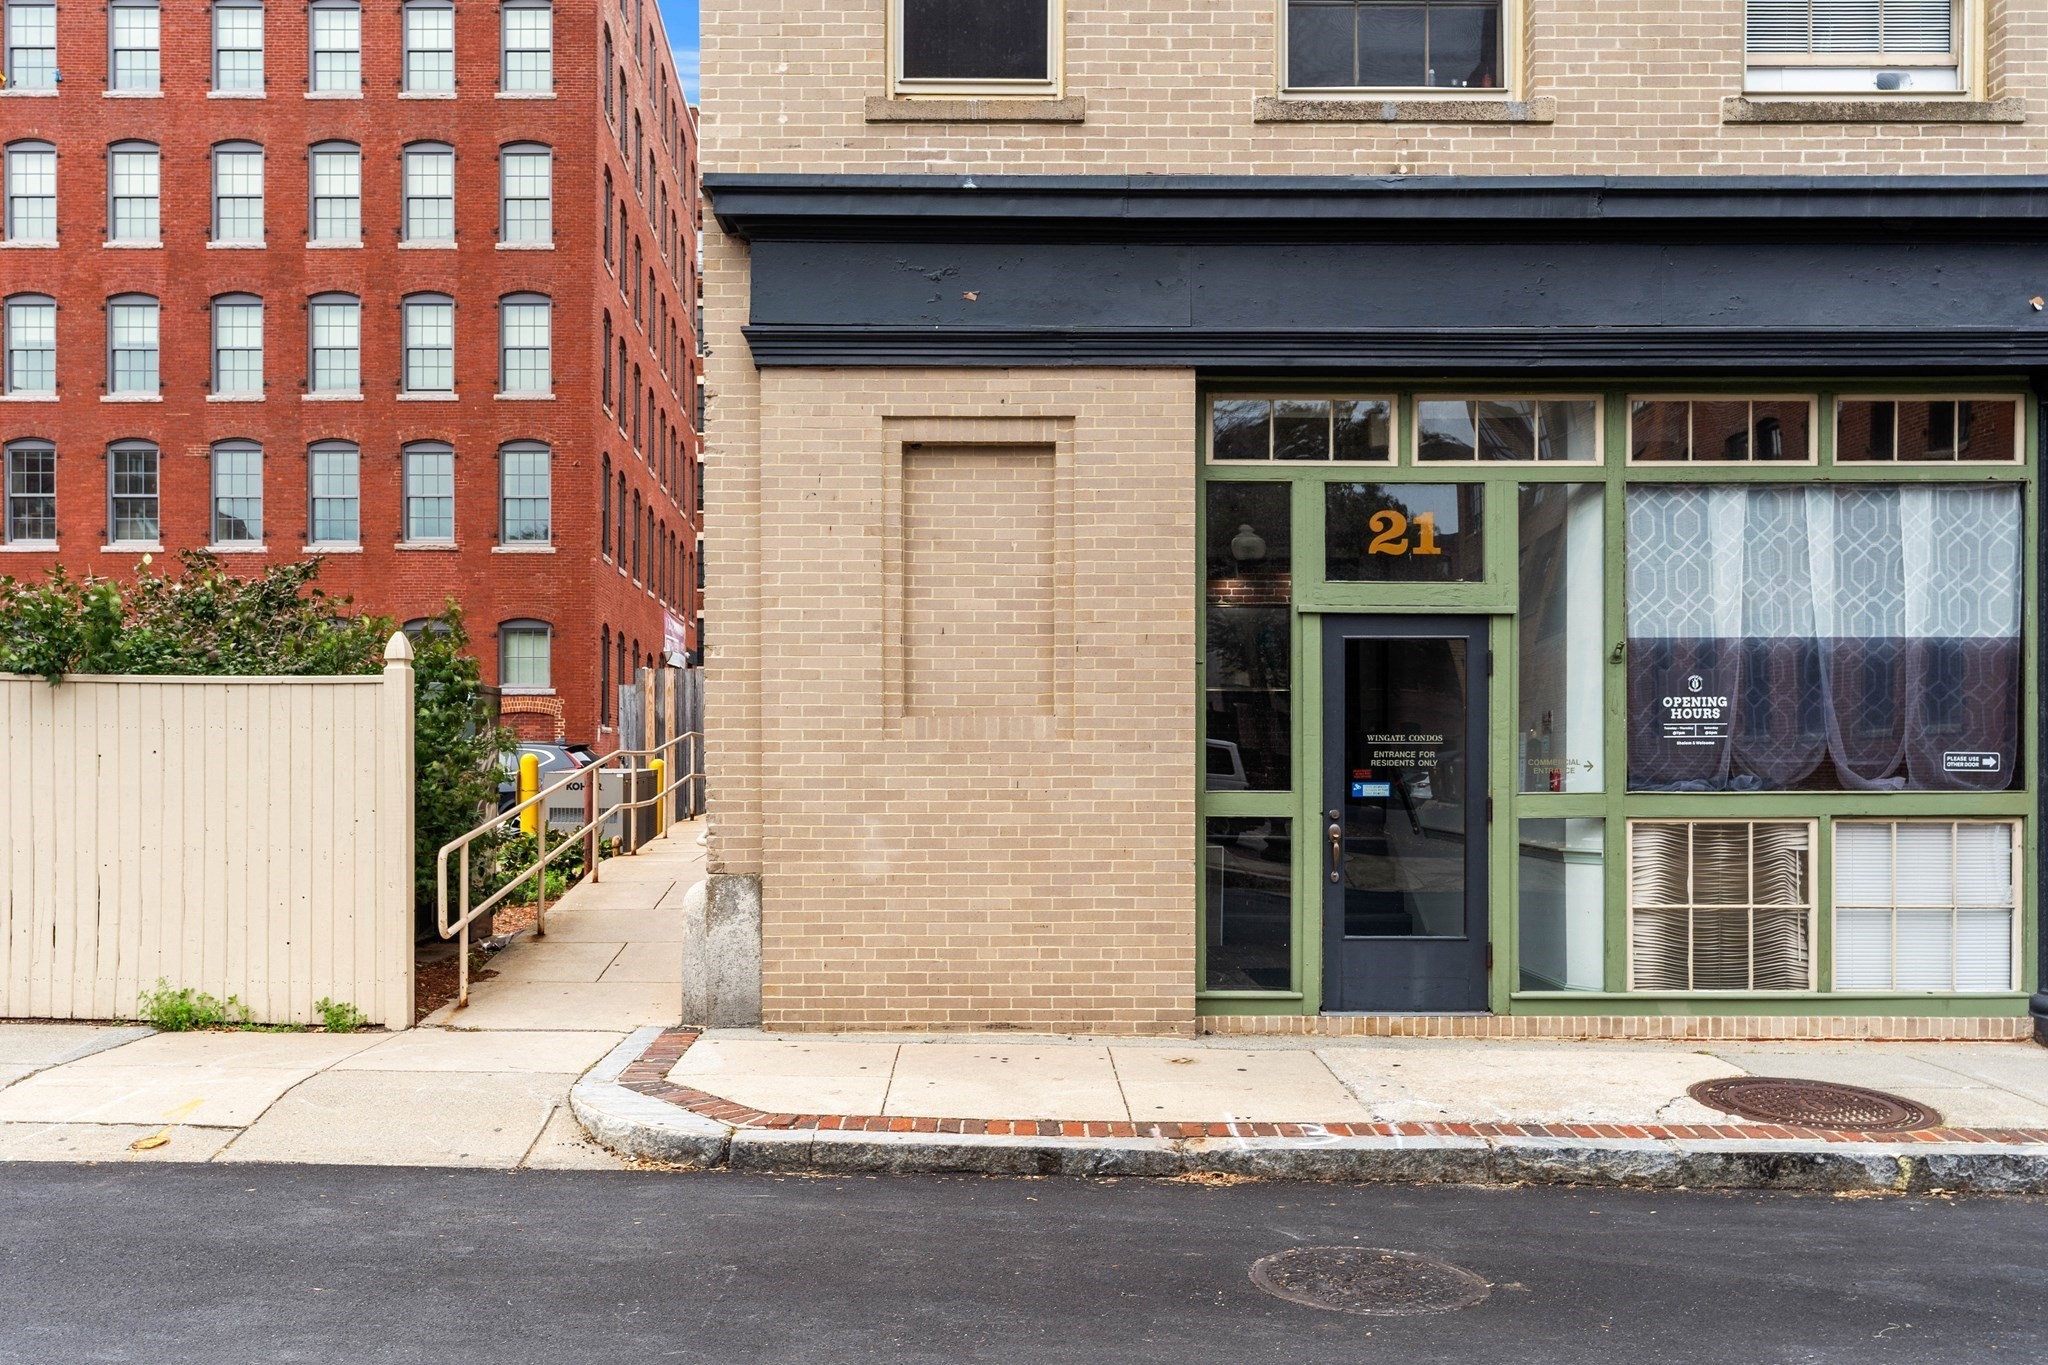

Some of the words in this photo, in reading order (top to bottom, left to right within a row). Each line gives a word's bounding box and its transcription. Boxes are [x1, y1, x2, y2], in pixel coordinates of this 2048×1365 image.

[1368, 510, 1441, 555] 21
[1662, 696, 1728, 707] OPENING
[1670, 708, 1721, 719] HOURS
[566, 782, 603, 791] KOHR
